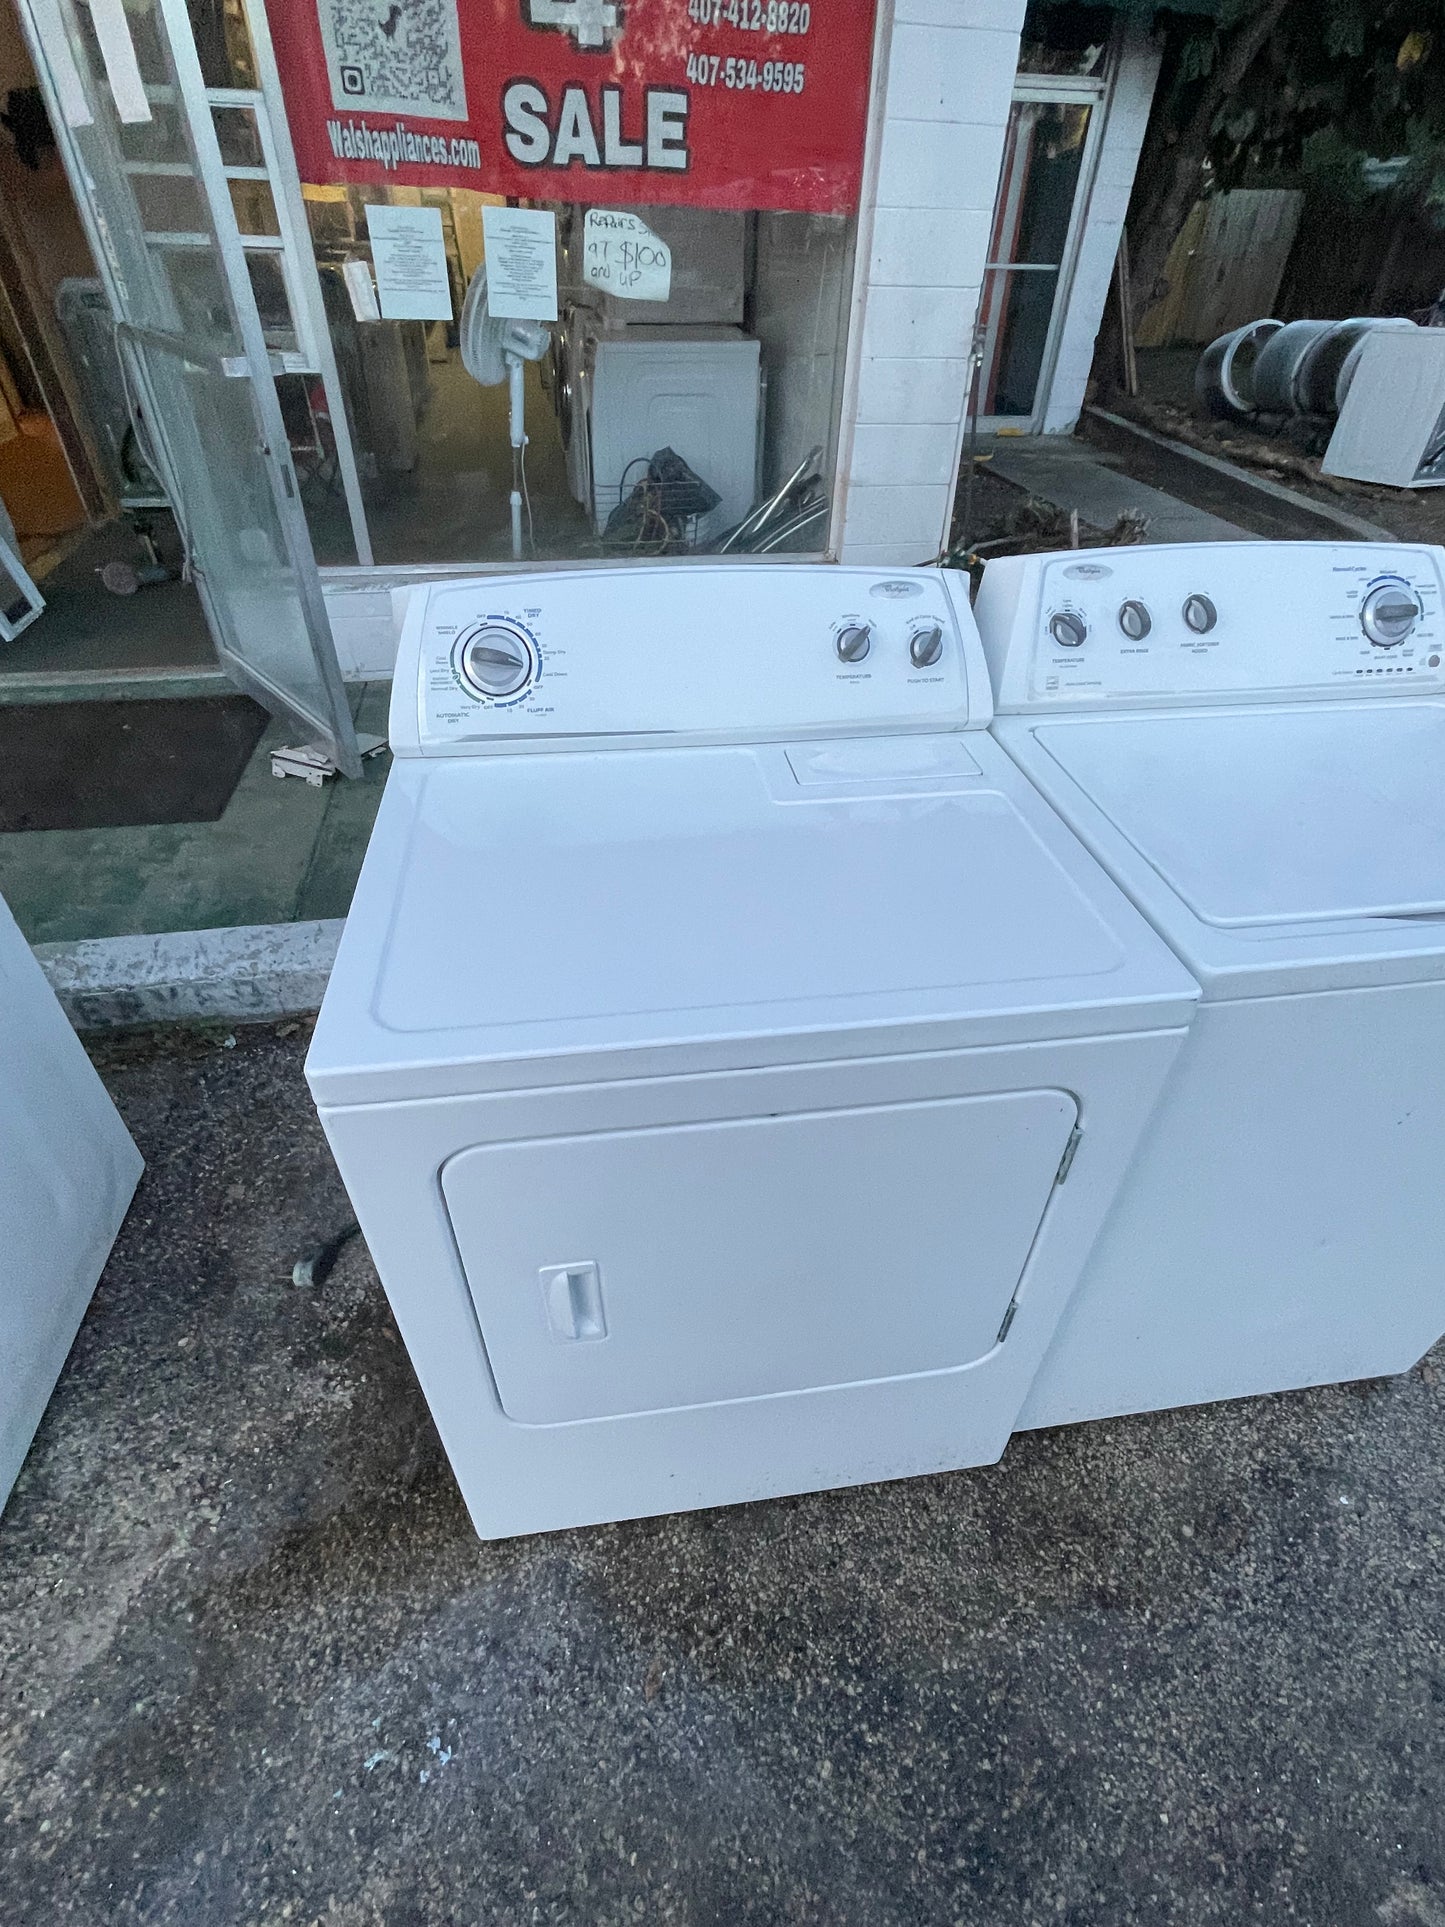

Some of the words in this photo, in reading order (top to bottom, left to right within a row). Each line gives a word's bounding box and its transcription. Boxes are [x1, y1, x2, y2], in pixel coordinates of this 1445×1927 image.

[688, 0, 811, 34] 407-412-8820
[686, 53, 805, 94] 407-534-9595
[326, 119, 481, 170] Walshappliances.com
[503, 82, 689, 171] SALE
[615, 241, 666, 270] $100
